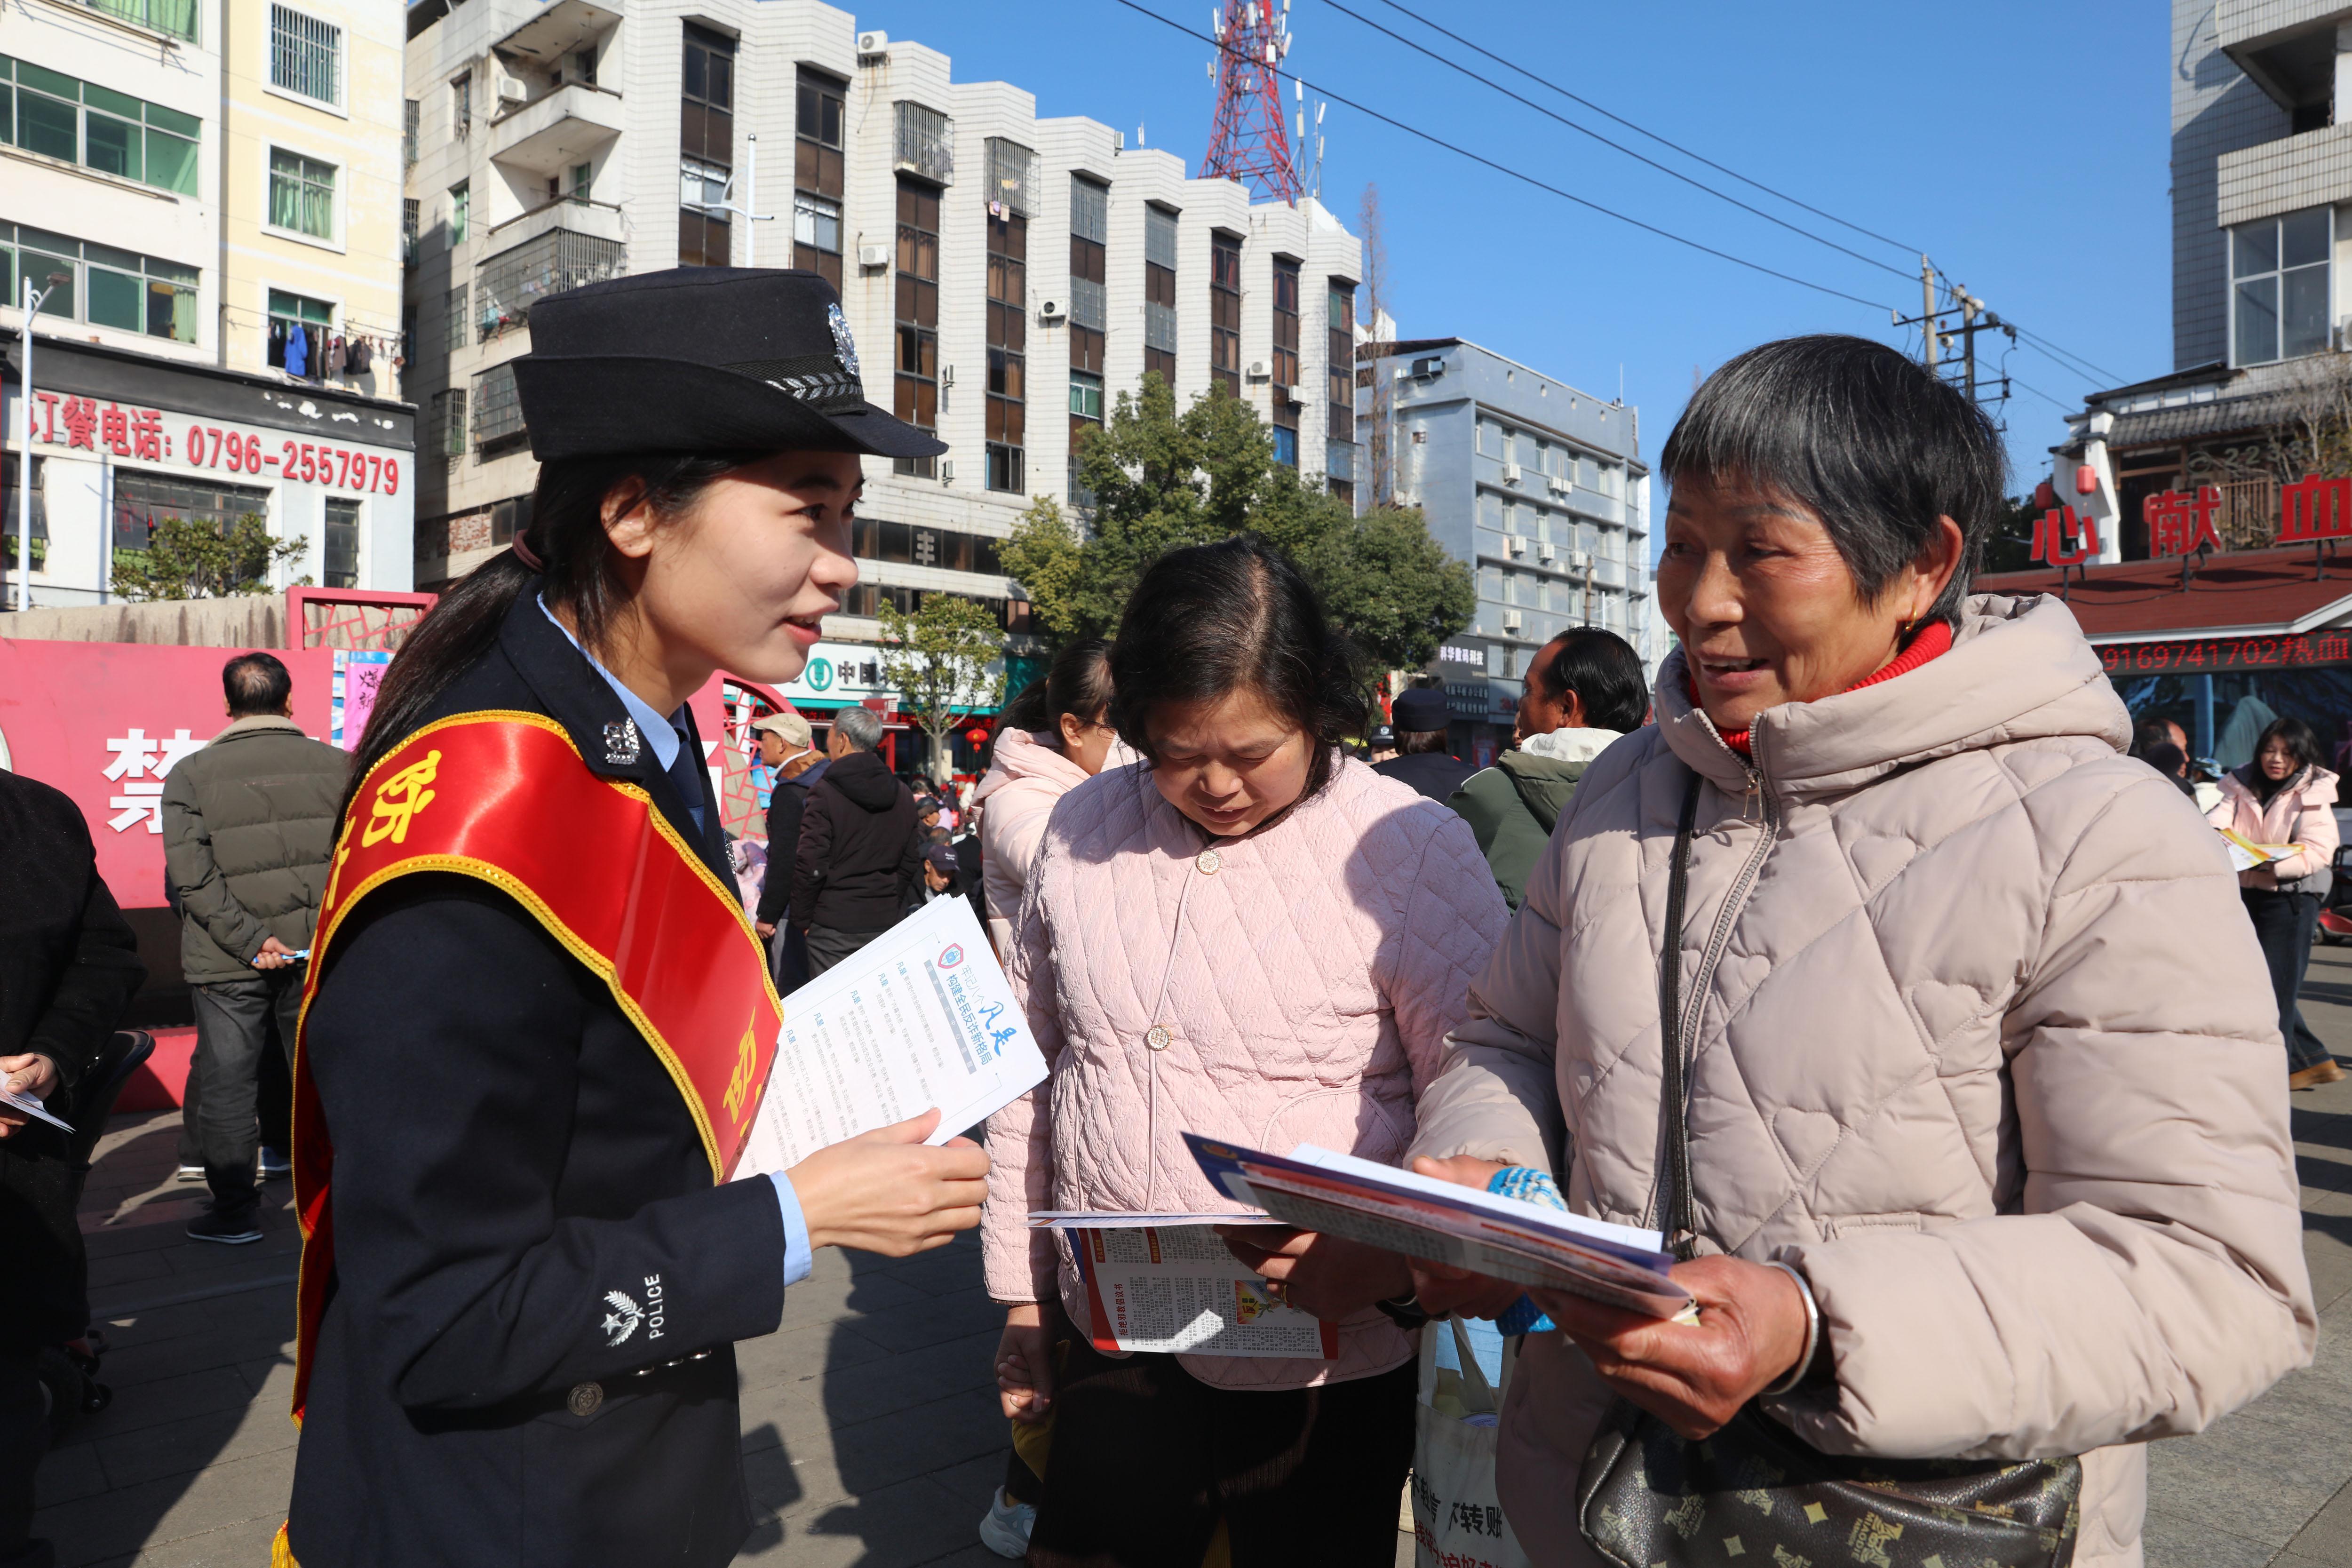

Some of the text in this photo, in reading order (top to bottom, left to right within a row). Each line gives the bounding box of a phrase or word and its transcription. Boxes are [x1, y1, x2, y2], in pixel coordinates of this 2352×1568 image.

[2095, 635, 2349, 671] 9169741702热血
[878, 972, 889, 987] 凡是
[896, 961, 907, 976] 凡是
[959, 964, 986, 1007] 牢记八个
[850, 989, 861, 1005] 凡是
[785, 1029, 796, 1044] 凡是
[813, 1012, 824, 1027] 凡是
[945, 973, 993, 1066] 构建全民反诈新格局
[644, 1273, 664, 1340] POLICE
[1114, 1282, 1128, 1336] 拒绝邪教倡议书
[1449, 1502, 1502, 1539] 不转账
[1851, 1511, 1875, 1559] MIAODIE
